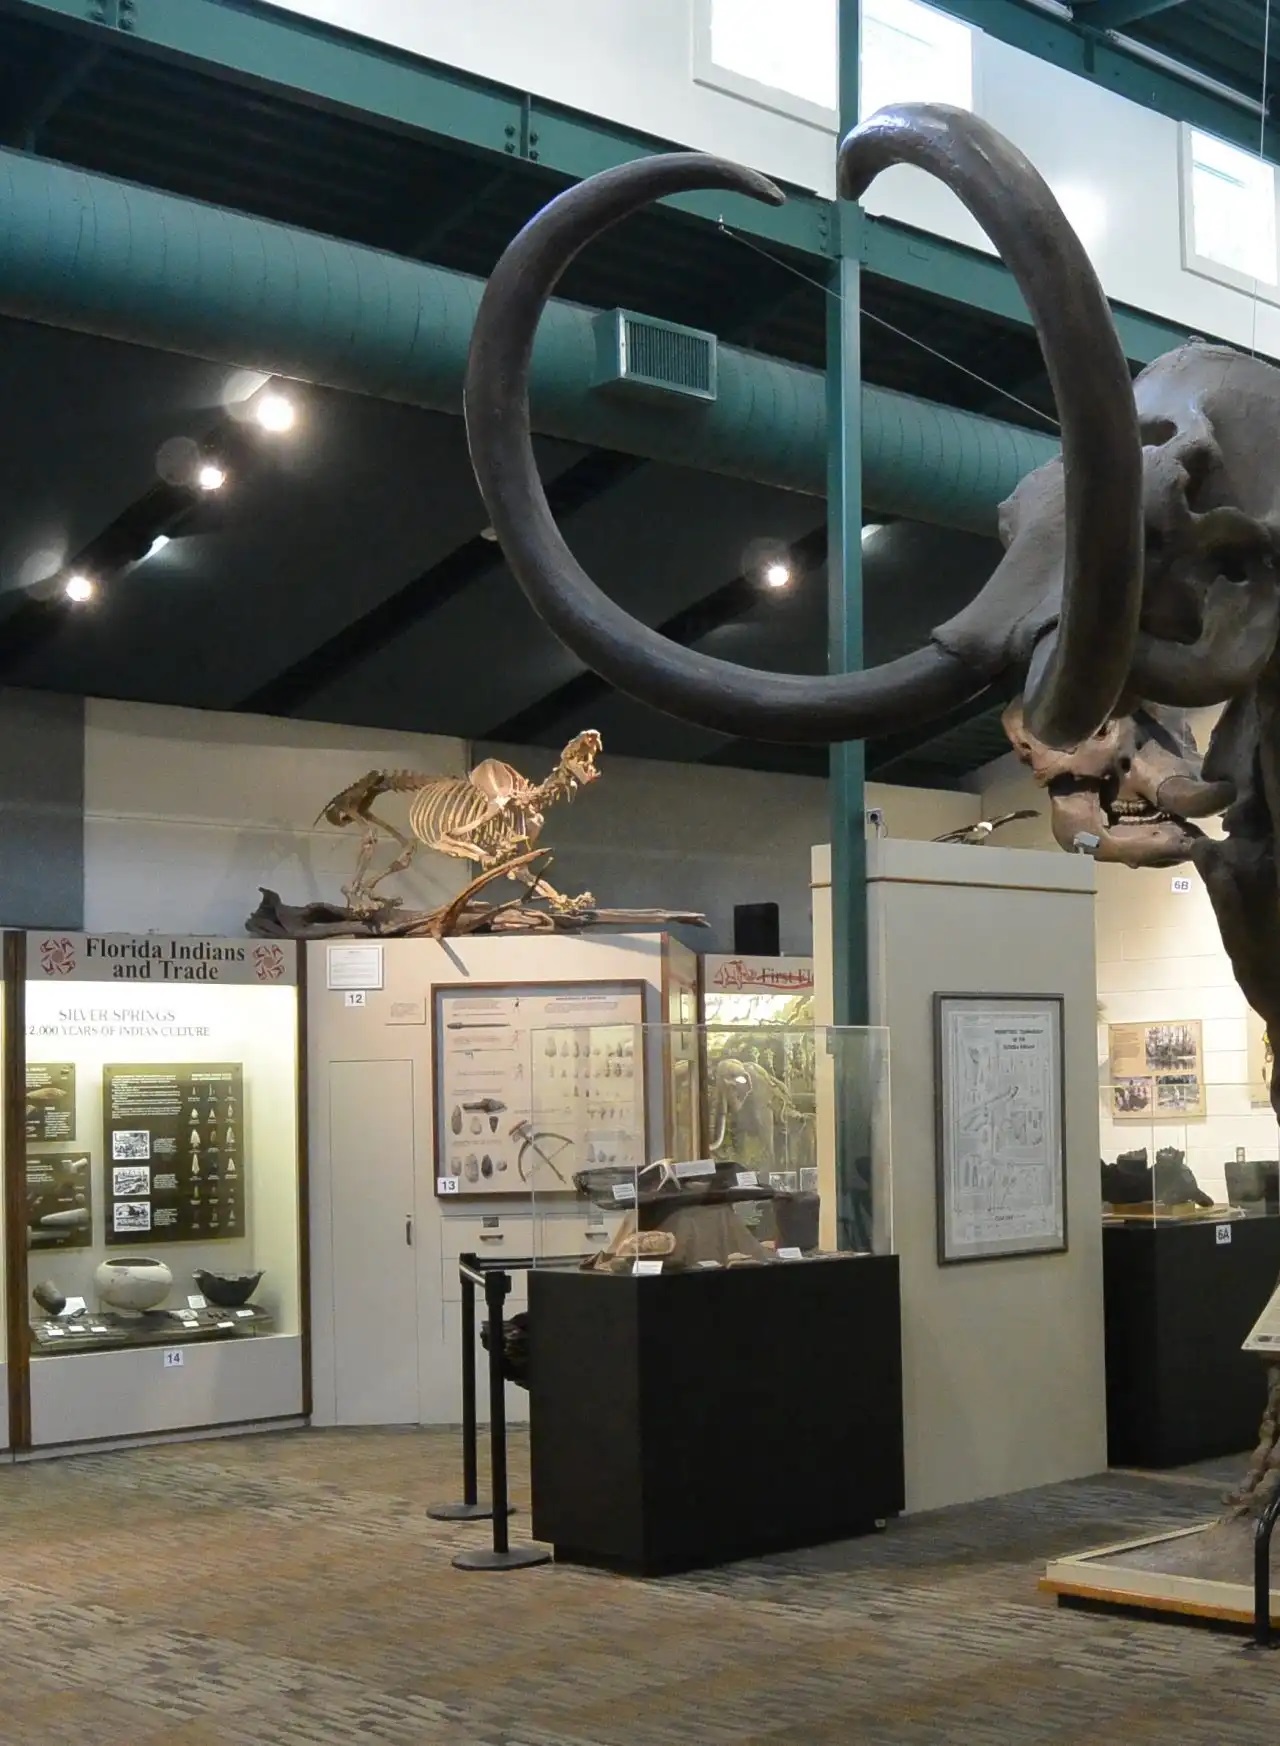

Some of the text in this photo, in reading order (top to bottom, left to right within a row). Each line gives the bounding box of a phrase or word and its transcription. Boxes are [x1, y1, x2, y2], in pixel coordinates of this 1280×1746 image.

[1173, 880, 1189, 891] 6B
[85, 938, 245, 961] Florida Indians
[112, 960, 219, 980] and Trade
[762, 967, 793, 983] First
[348, 994, 364, 1004] 12
[59, 1008, 175, 1022] SILVER SPRINGS
[25, 1025, 210, 1037] 2,000 YEARS OF INDIAN CULTURE
[442, 1180, 456, 1191] 13
[1217, 1227, 1230, 1241] 6A
[167, 1352, 181, 1365] 14
